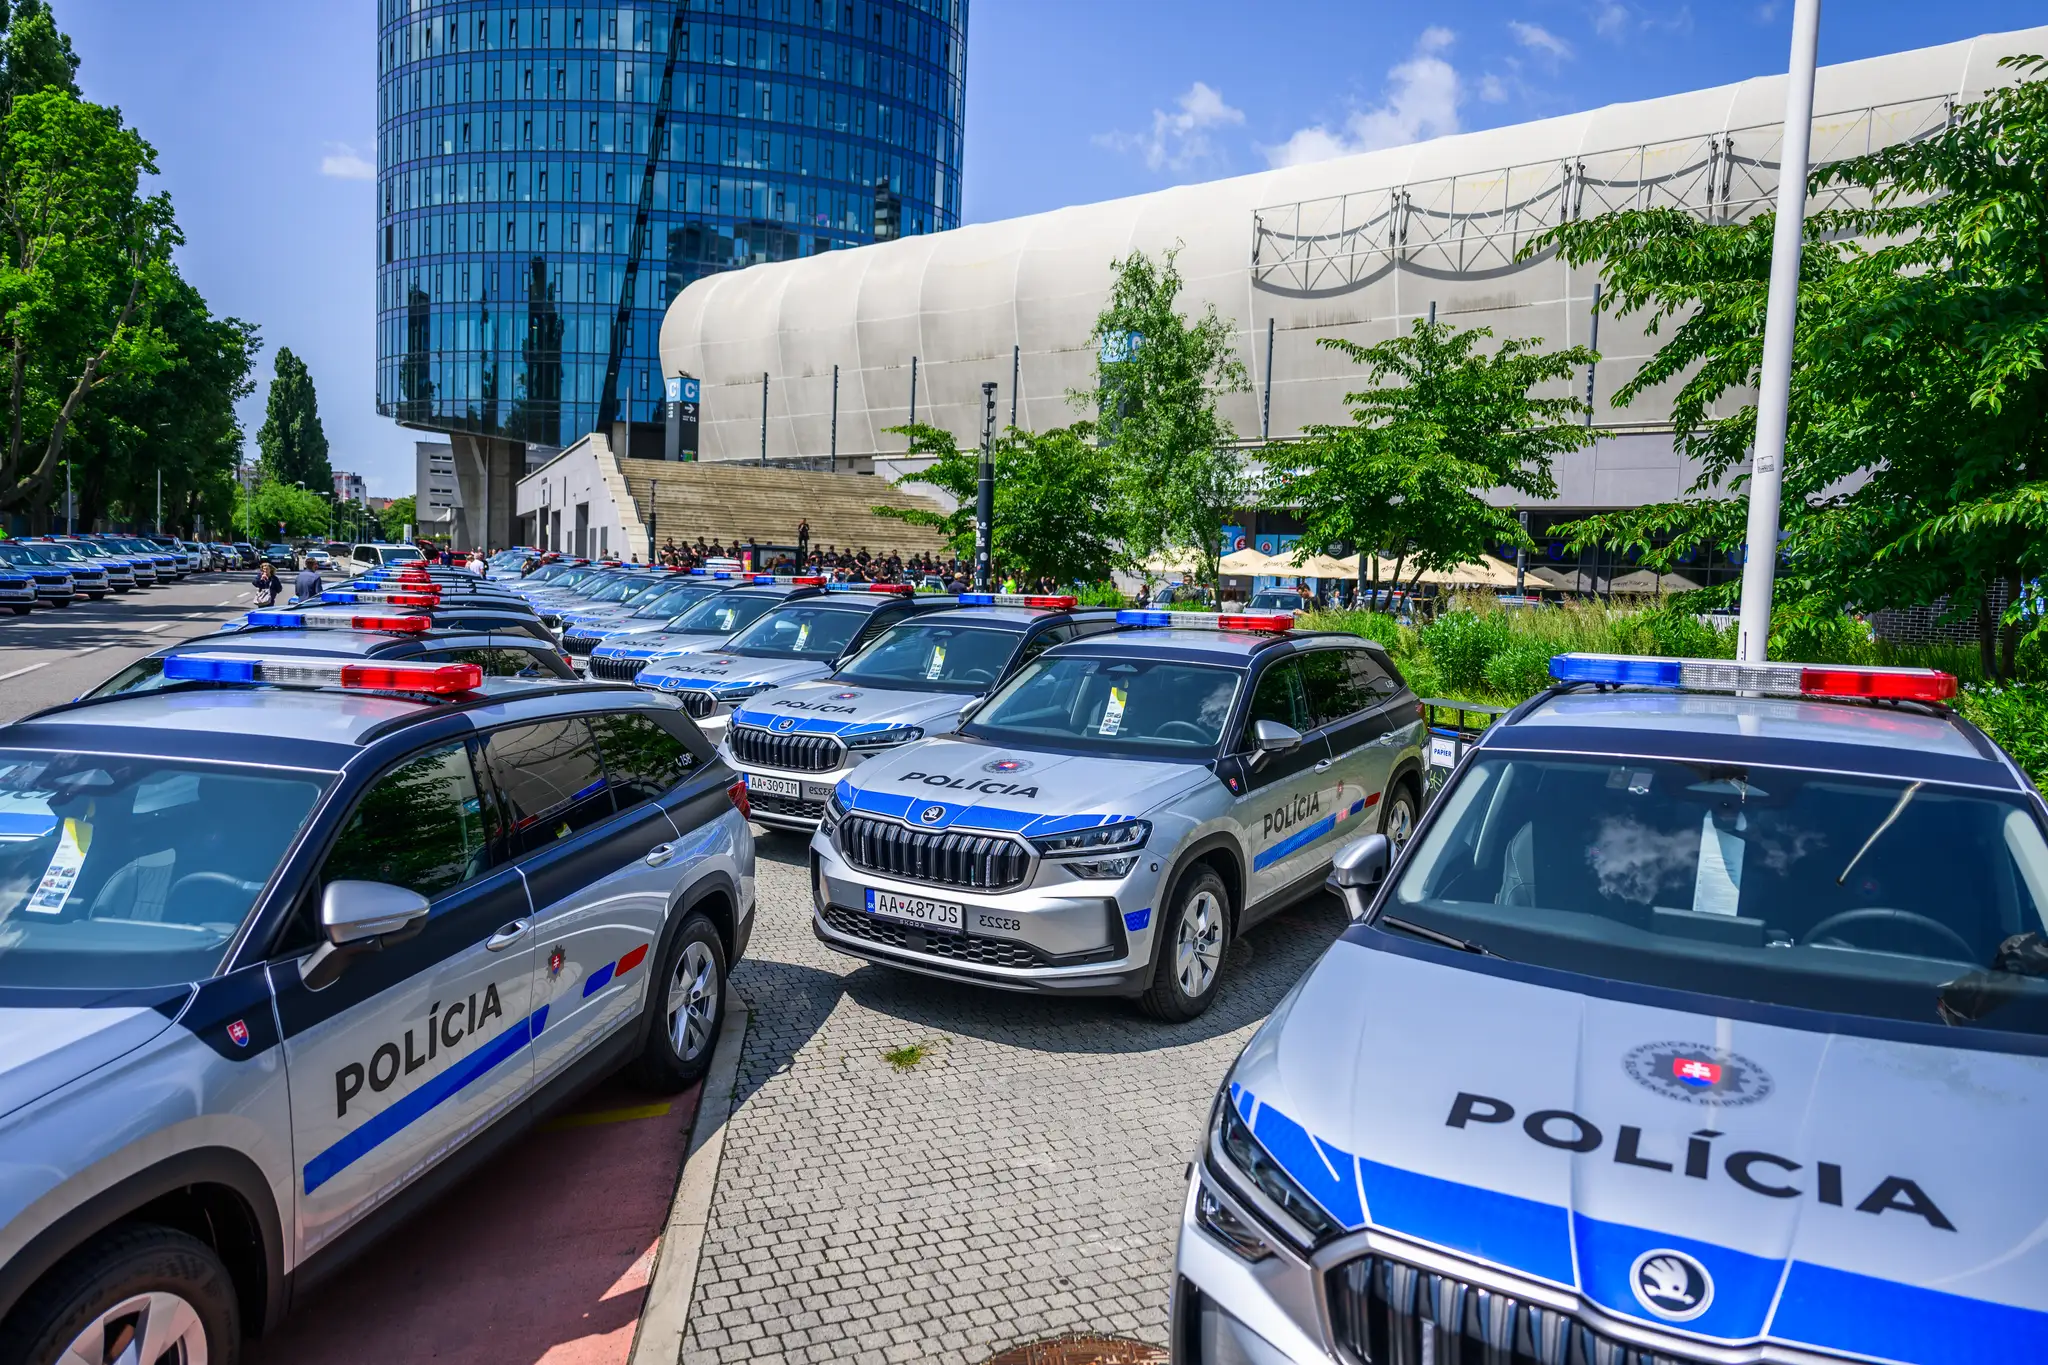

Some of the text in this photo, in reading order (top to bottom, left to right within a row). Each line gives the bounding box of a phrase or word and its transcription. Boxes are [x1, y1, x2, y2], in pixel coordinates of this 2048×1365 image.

[666, 665, 729, 676] POLÍCIA
[772, 700, 857, 714] POLÍCIA
[1433, 748, 1452, 757] PAPIER
[898, 772, 1039, 799] POLÍCIA
[1263, 791, 1321, 839] POLÍCIA
[867, 901, 875, 909] SK
[335, 981, 504, 1118] POLÍCIA
[1445, 1090, 1958, 1233] POLÍCIA
